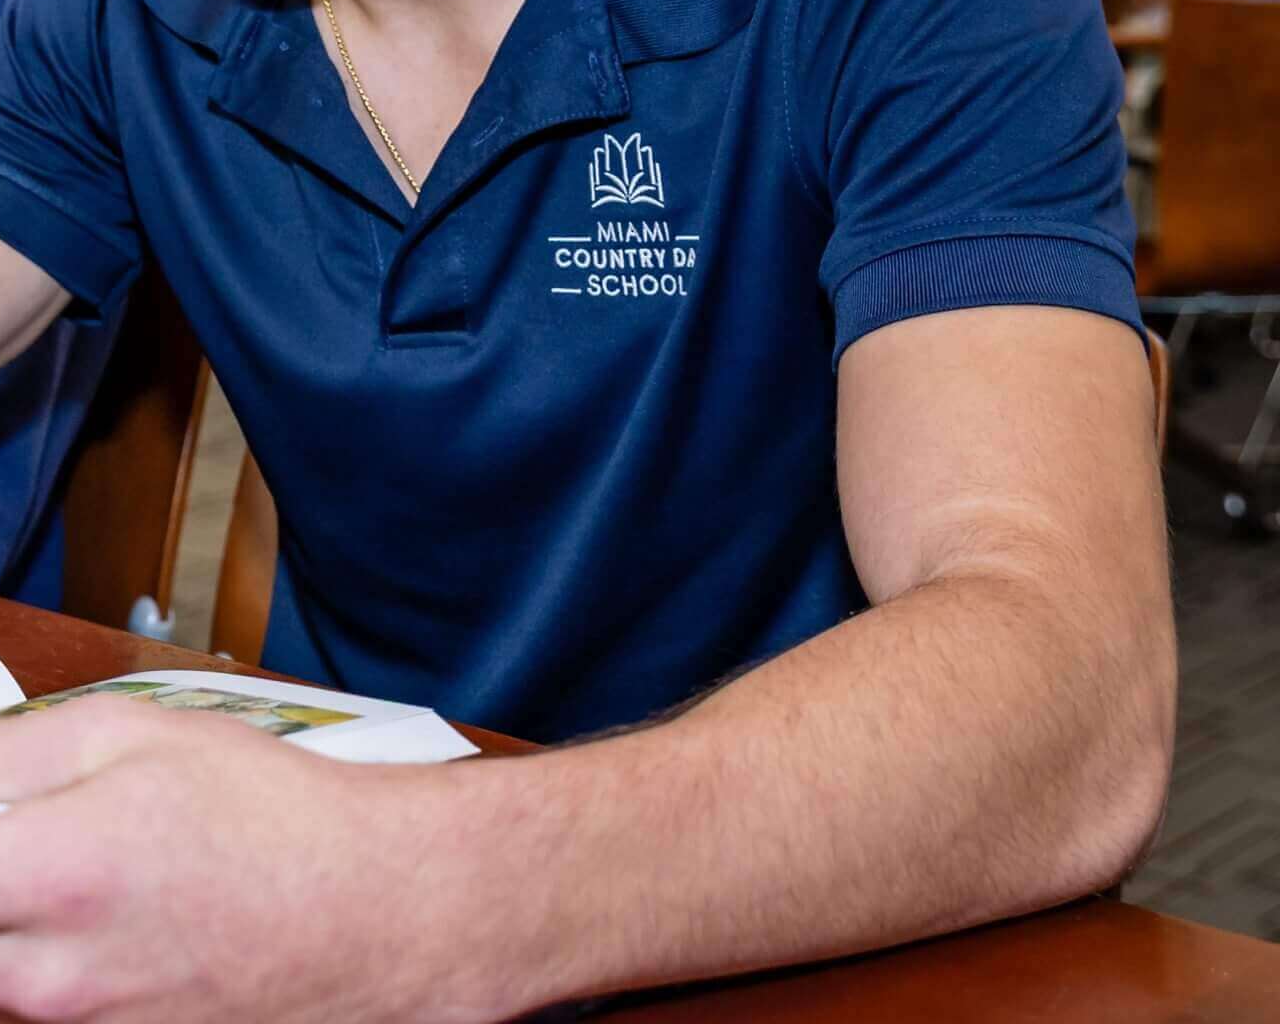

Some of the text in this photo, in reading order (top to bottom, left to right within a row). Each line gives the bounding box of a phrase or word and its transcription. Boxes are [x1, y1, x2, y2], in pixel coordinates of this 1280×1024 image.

[596, 221, 671, 243] MIAMI
[555, 248, 666, 269] COUNTRY
[587, 274, 688, 297] SCHOOL
